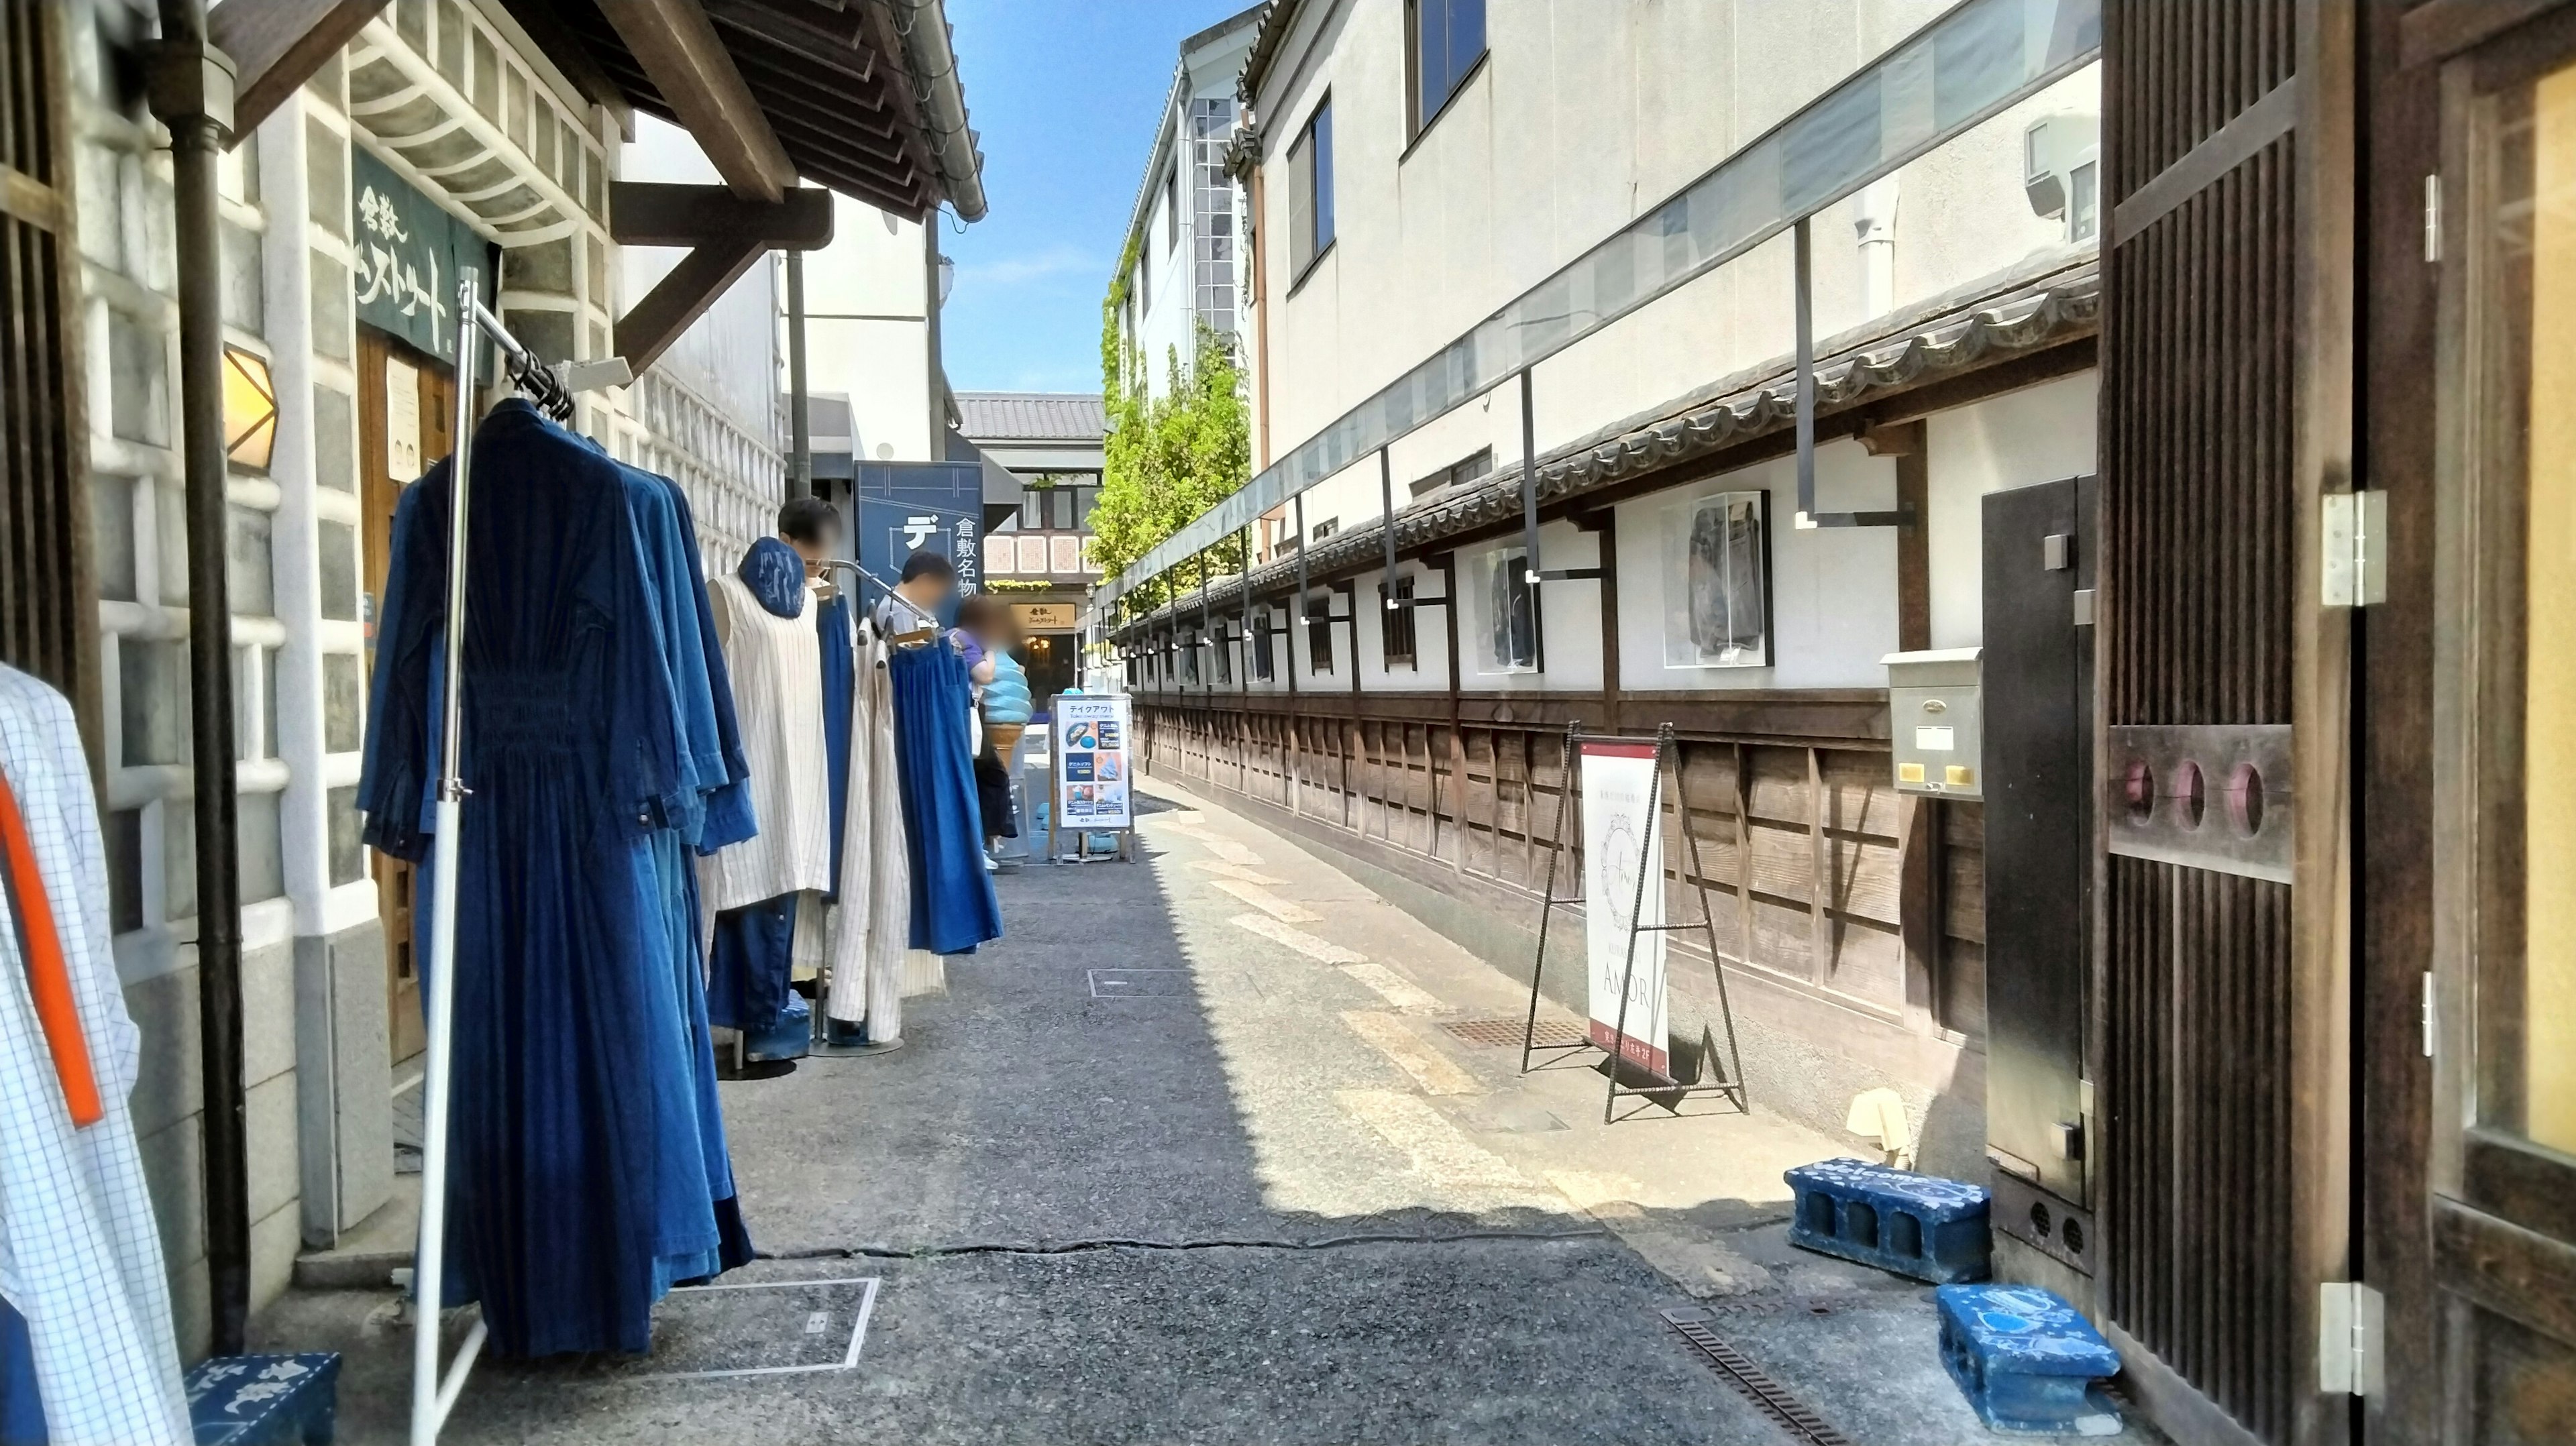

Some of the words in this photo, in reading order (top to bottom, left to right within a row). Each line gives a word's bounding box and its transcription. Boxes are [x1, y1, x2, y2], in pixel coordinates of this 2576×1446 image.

[904, 514, 939, 550] デ
[956, 517, 977, 599] 倉敷名物
[1604, 961, 1650, 1008] AMOR
[1813, 1162, 1929, 1183] Welcome
